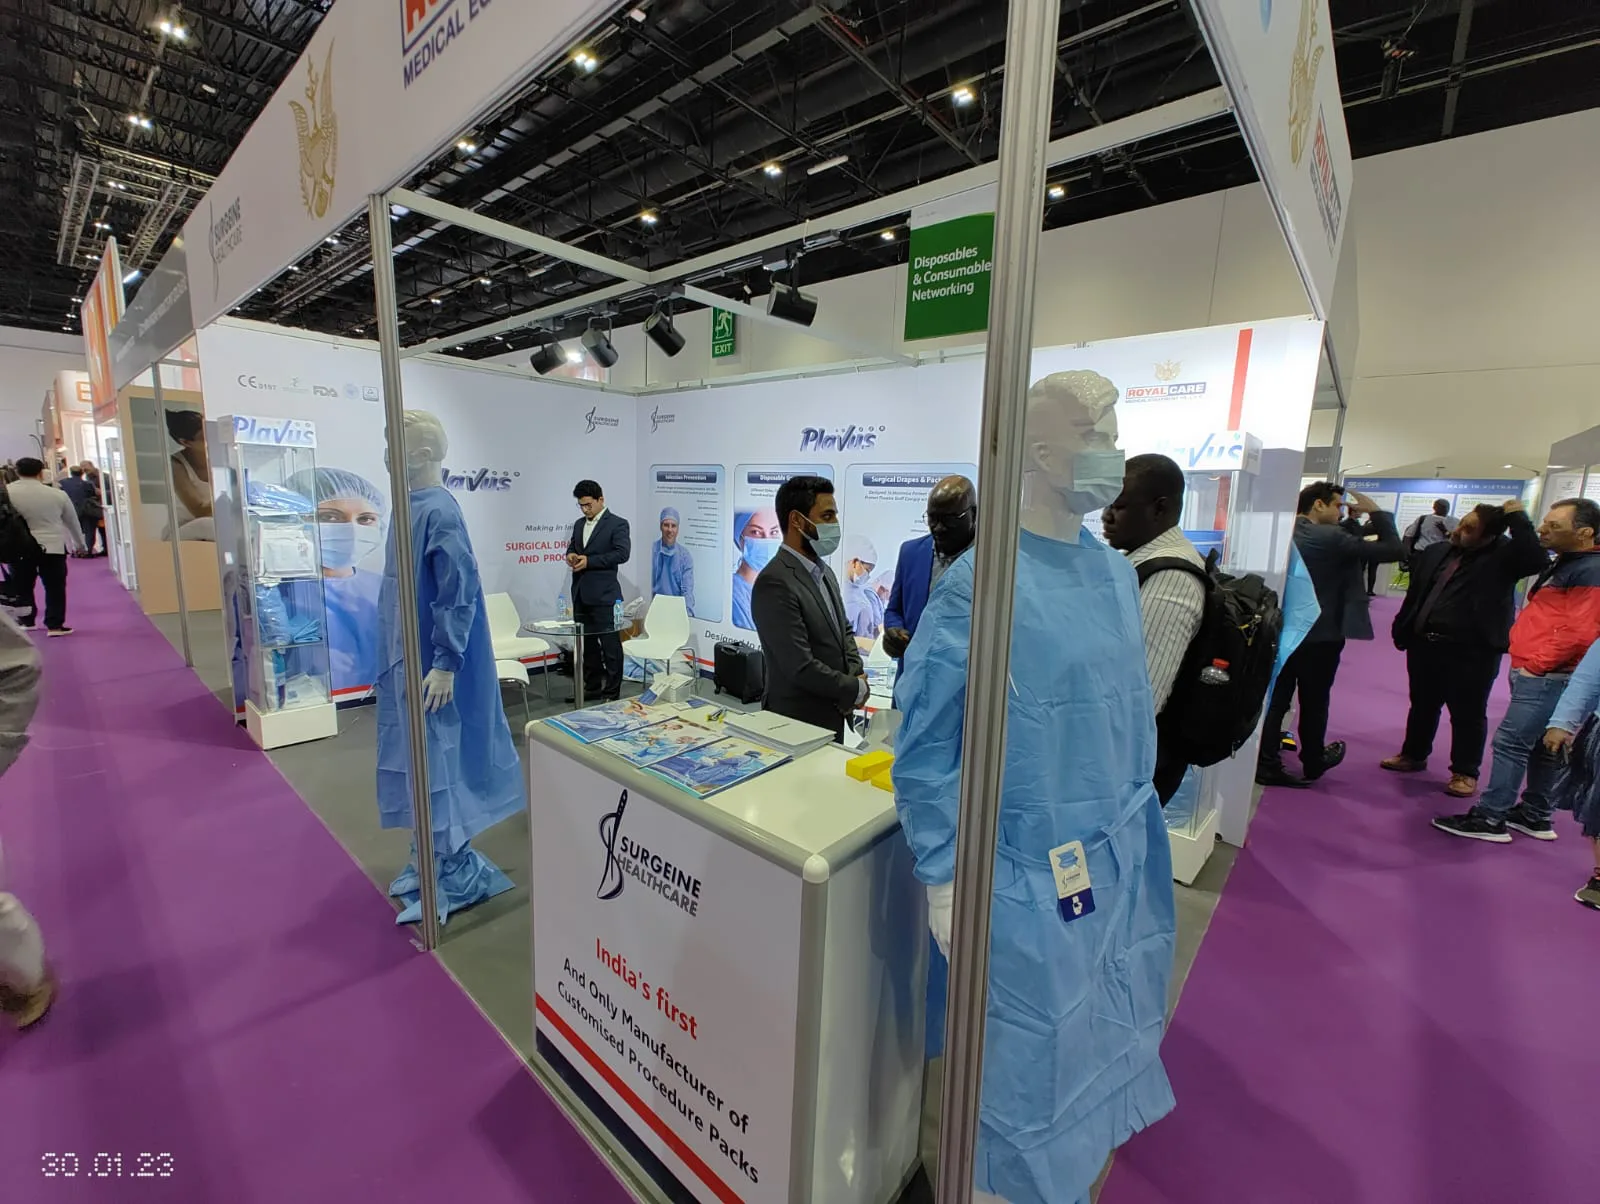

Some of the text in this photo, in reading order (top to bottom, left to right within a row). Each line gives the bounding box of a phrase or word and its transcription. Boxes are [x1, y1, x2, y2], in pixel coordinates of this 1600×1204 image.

[403, 6, 465, 90] MEDICAL
[913, 245, 978, 270] Disposables
[912, 259, 993, 286] & Consumable
[911, 281, 974, 302] Networking
[714, 343, 732, 355] EXIT
[1128, 387, 1167, 398] ROYAL
[1168, 383, 1204, 395] CARE
[871, 475, 896, 484] Surgical
[897, 476, 916, 485] Drapes
[525, 524, 554, 533] Making
[505, 541, 552, 552] SURGICAL
[518, 553, 567, 564] AND PROC
[620, 836, 702, 899] SURGEINE
[616, 852, 699, 918] HEALTHCARE
[596, 938, 698, 1041] India's first
[563, 957, 749, 1134] And Only Manufacturer of
[557, 980, 759, 1184] Customised Procedure Packs
